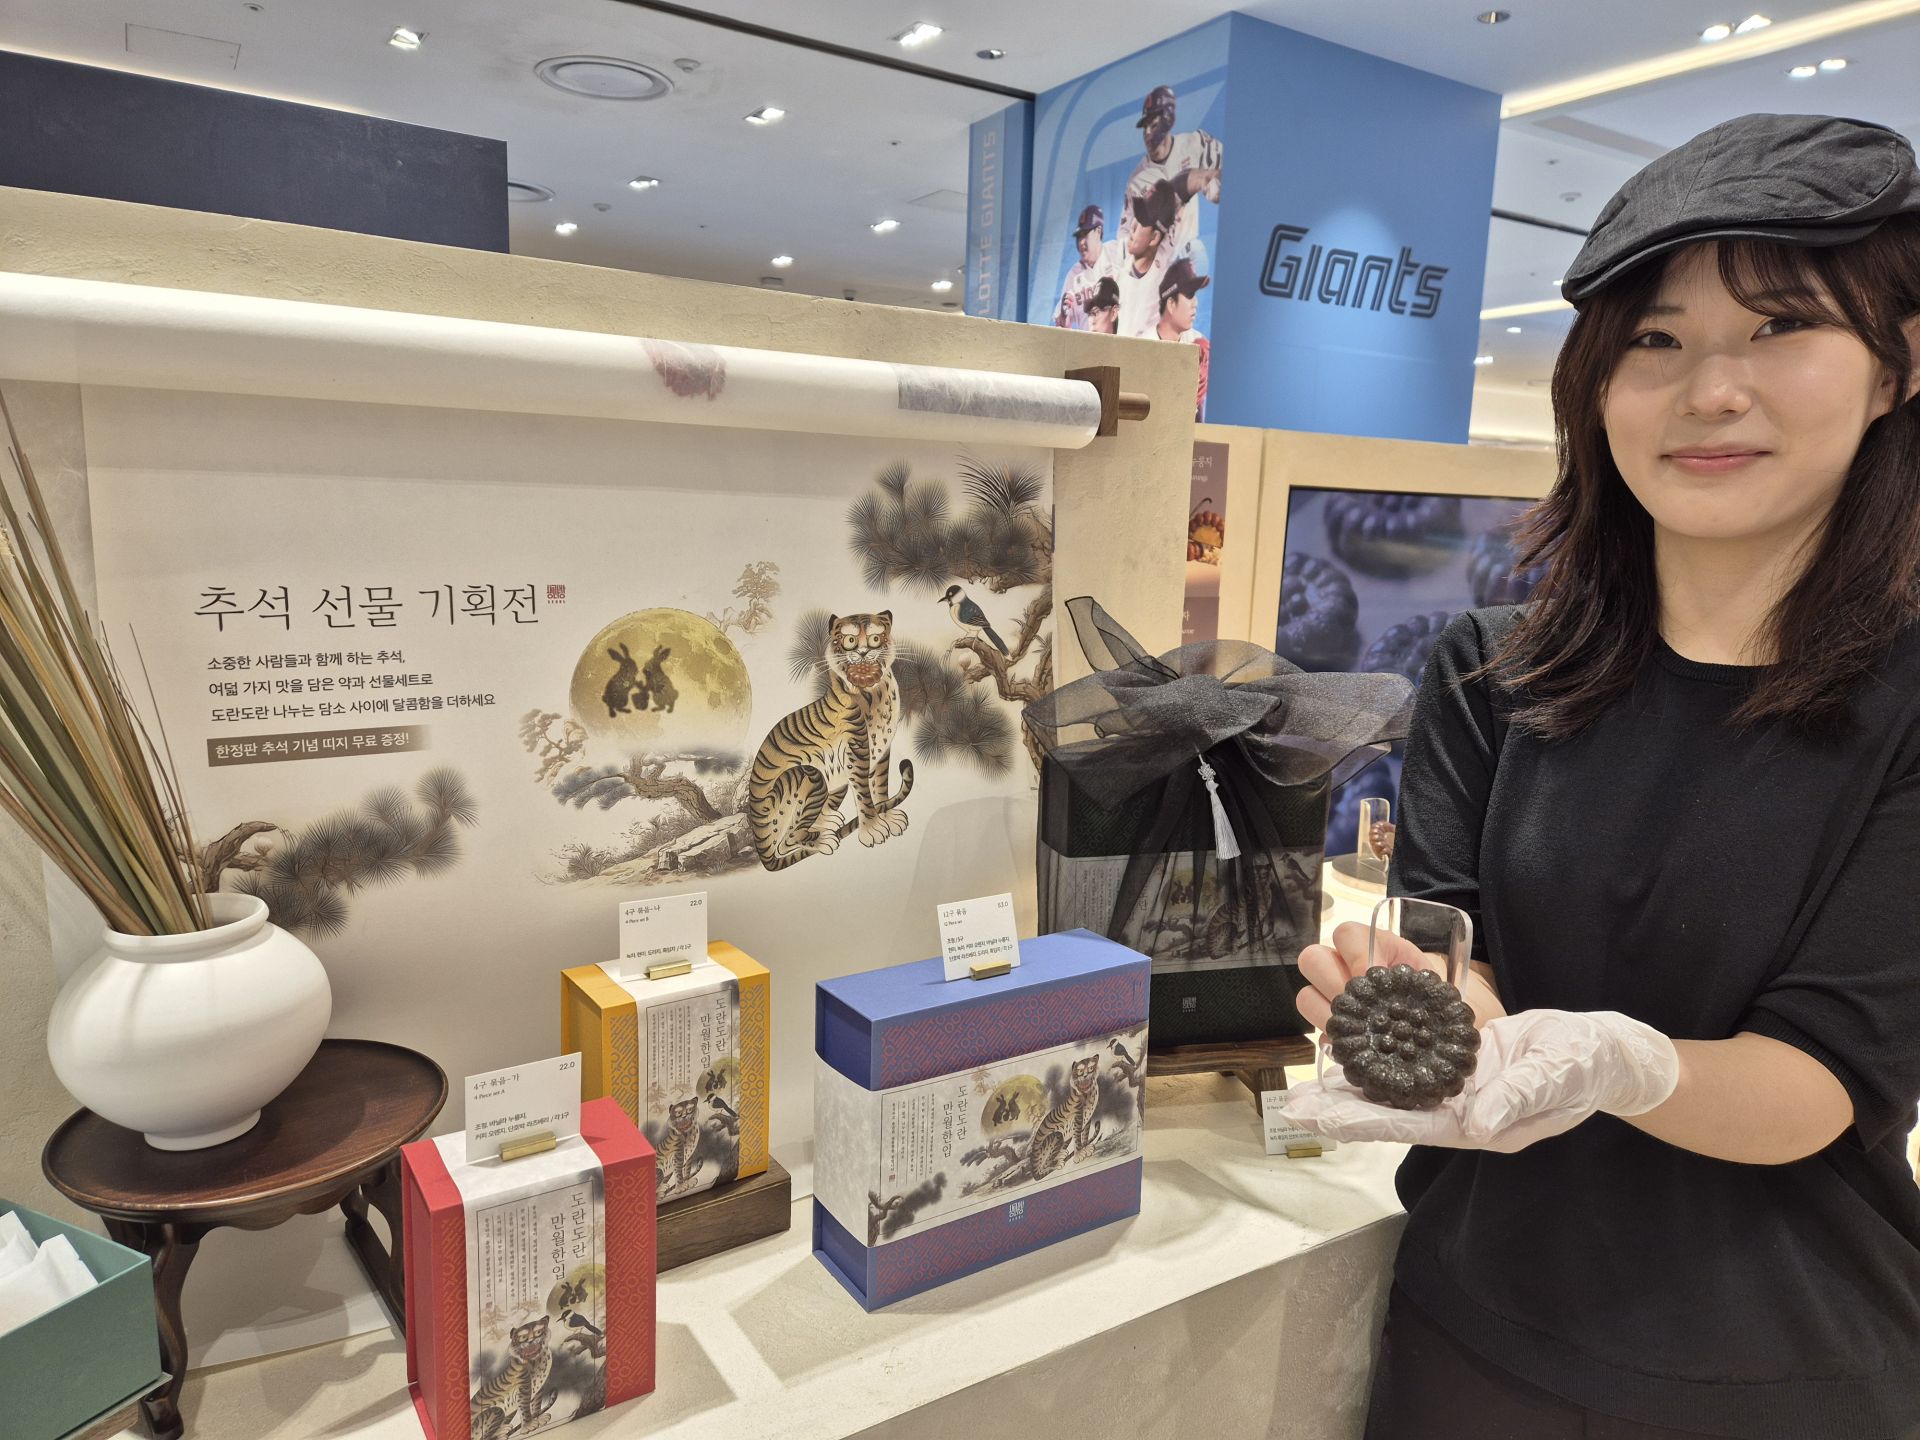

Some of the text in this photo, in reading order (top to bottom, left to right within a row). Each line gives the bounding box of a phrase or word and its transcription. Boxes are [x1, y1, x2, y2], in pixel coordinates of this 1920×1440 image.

[978, 131, 997, 315] LOTTE GIANTS
[1259, 223, 1449, 319] Giants
[194, 583, 539, 632] 추석 선물 기획전
[207, 650, 406, 671] 소중한 사람들과 함께 하는 추석,
[208, 673, 434, 697] 여덟 가지 맛을 담은 약과 선물세트로
[211, 693, 496, 722] 도란도란 나누는 담소 사이에 달콤함을 더하세요
[215, 732, 410, 759] 한정판 추석 기념 띠지 무료 증정!
[715, 997, 727, 1052] 도란도란
[559, 1061, 575, 1071] 22.0
[956, 1085, 969, 1141] 도란도란
[570, 1192, 586, 1259] 도란도란
